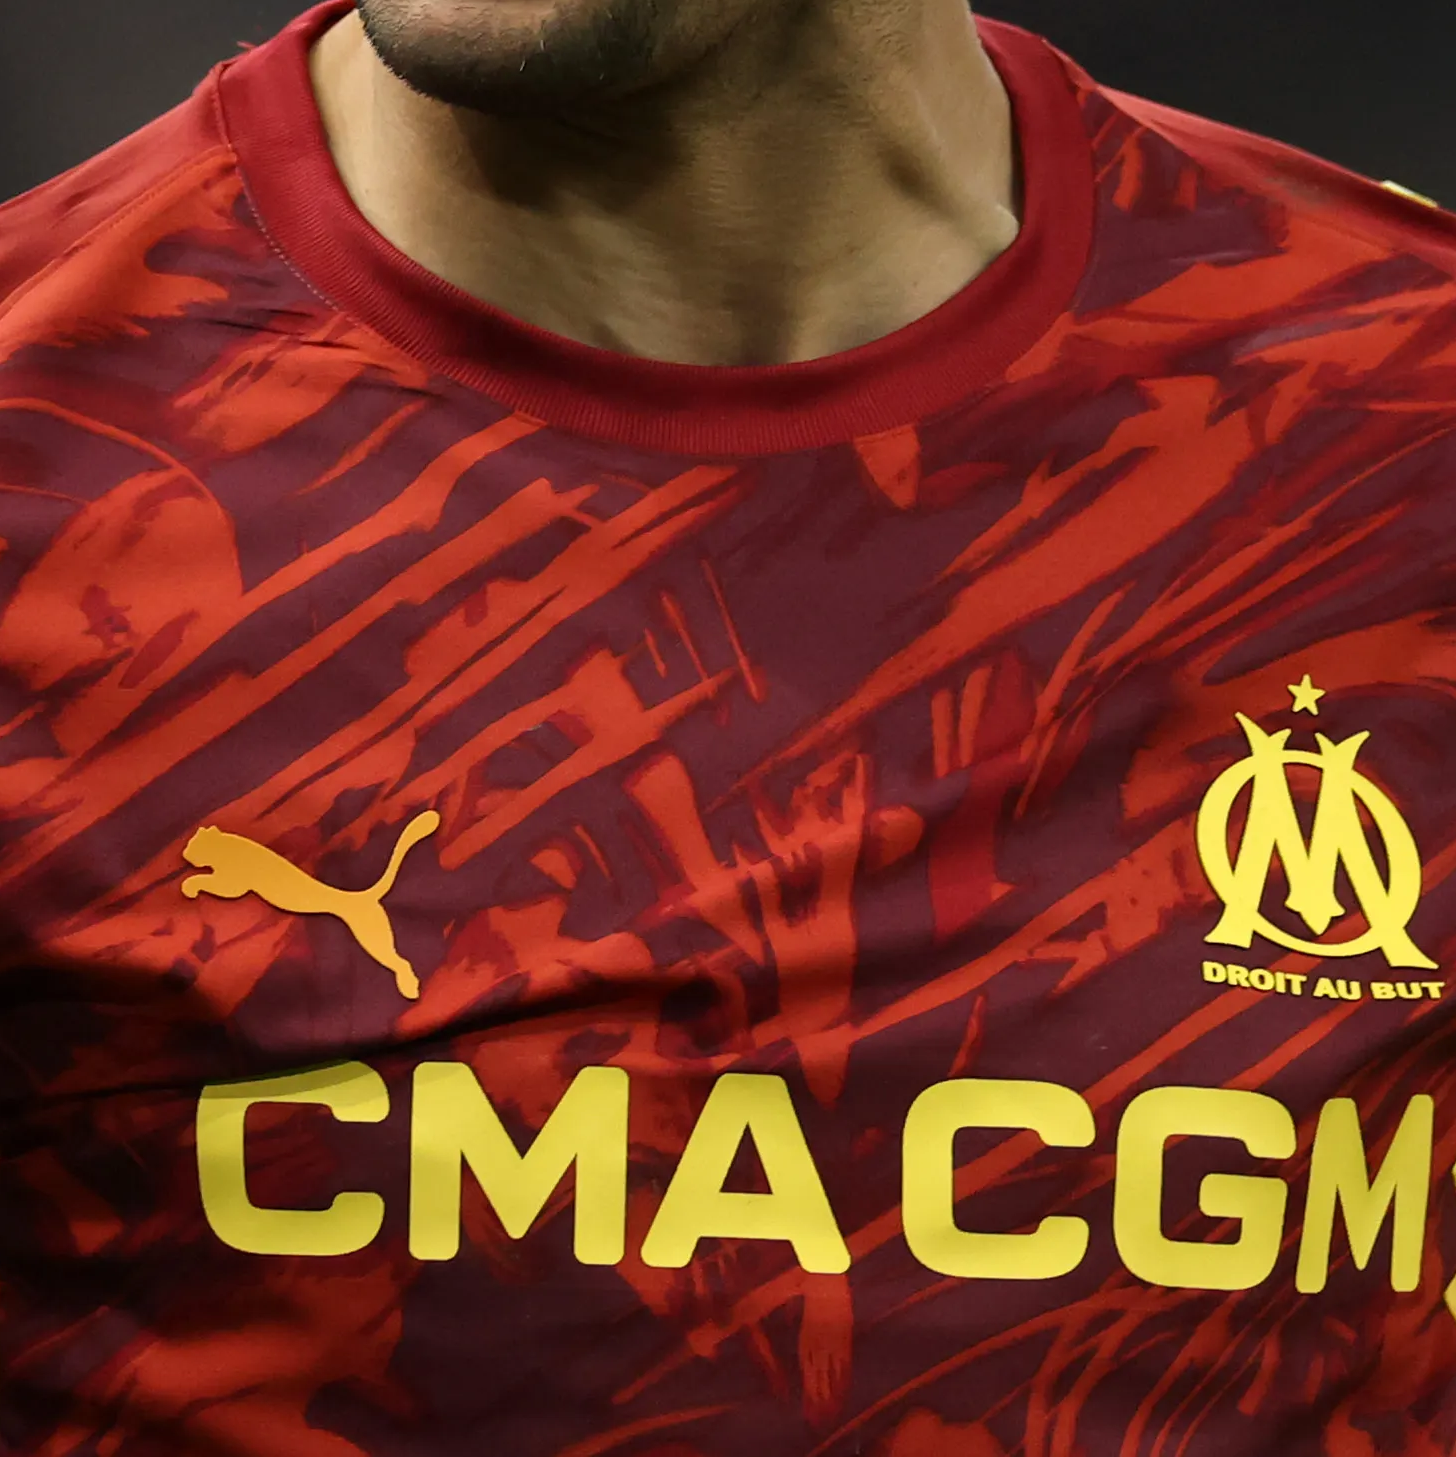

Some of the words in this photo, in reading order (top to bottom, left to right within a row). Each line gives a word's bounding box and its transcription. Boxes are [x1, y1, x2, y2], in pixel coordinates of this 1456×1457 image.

[1201, 960, 1307, 996] DROIT
[1312, 976, 1362, 1001] AU
[1370, 981, 1446, 1000] BUT
[196, 1060, 851, 1275] CMA
[901, 1077, 1435, 1294] CGM
